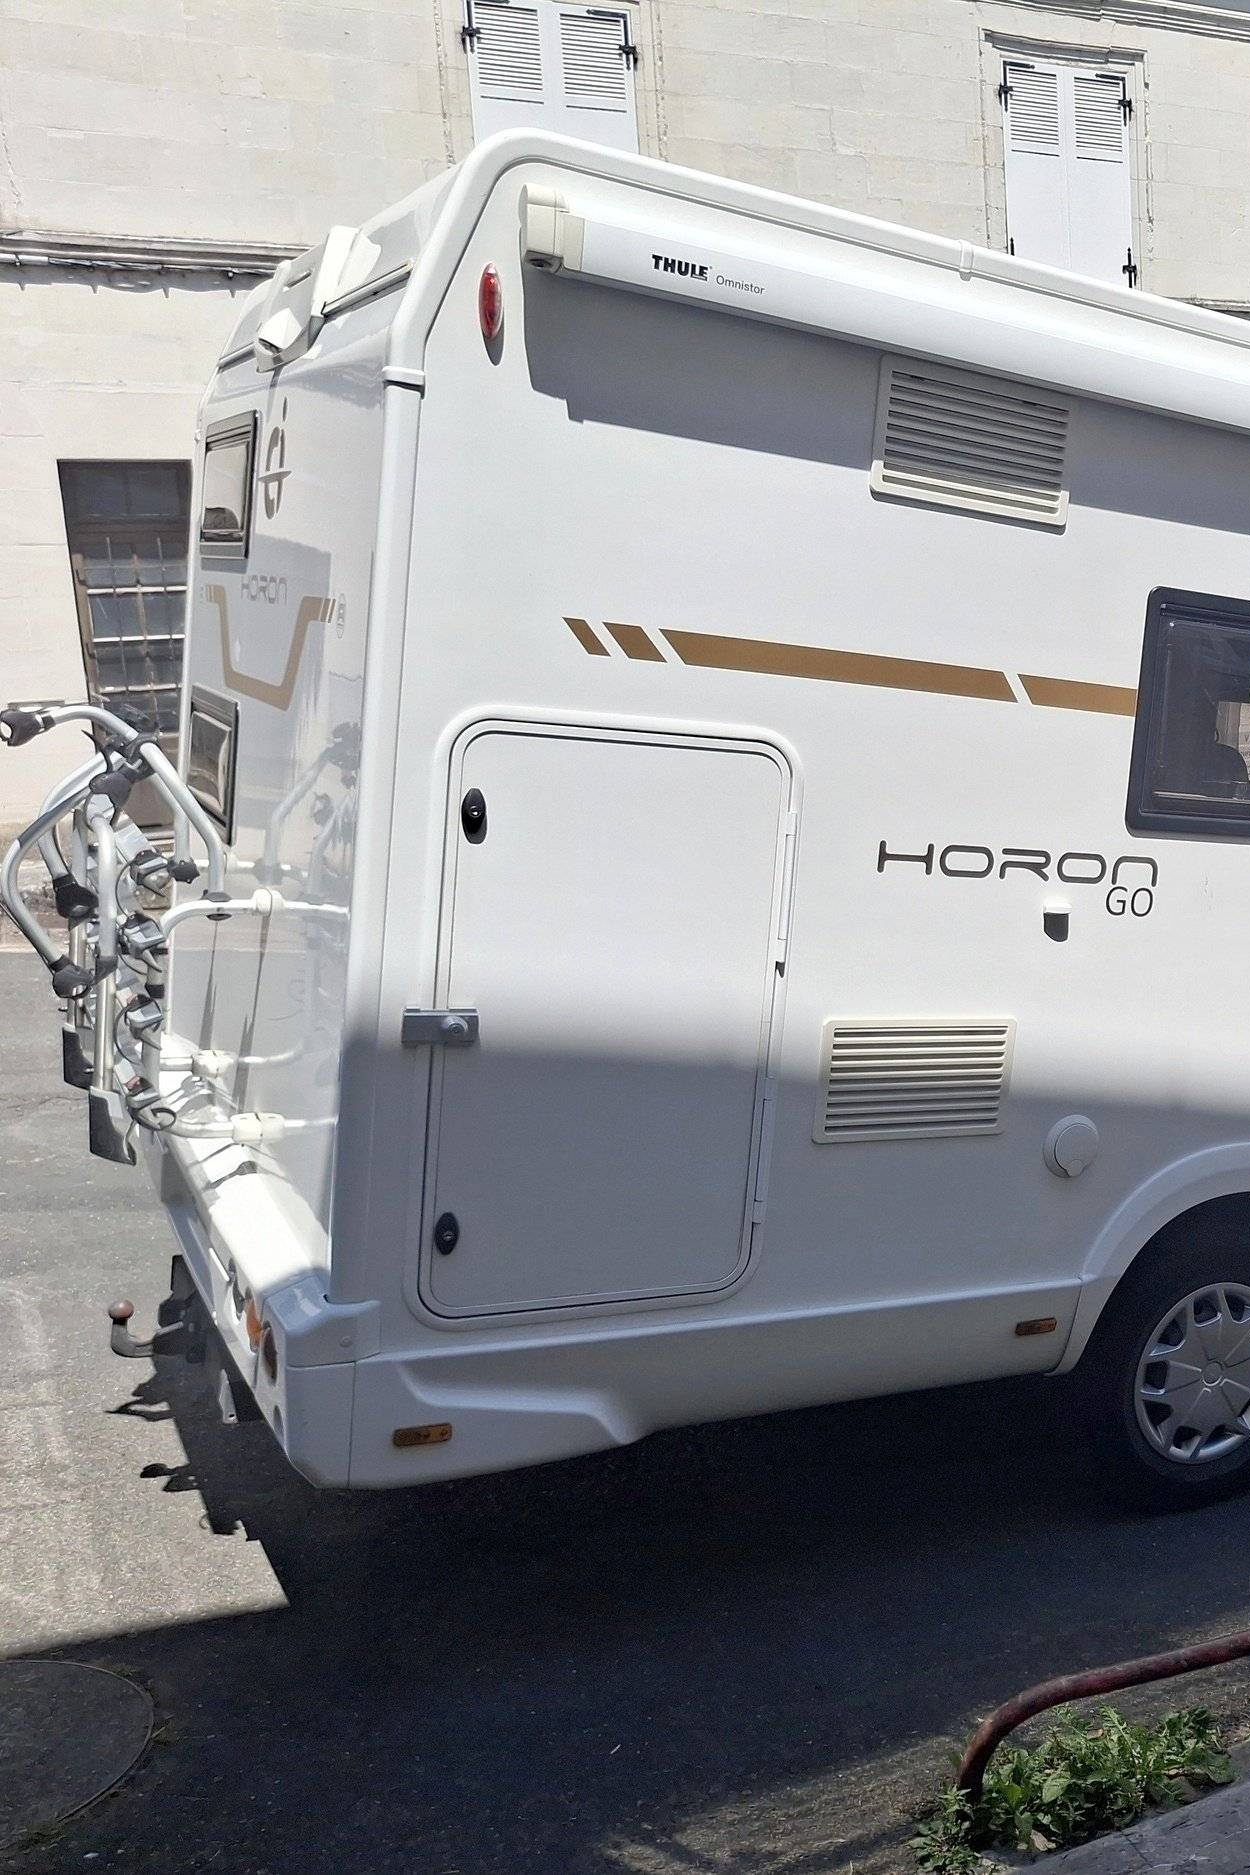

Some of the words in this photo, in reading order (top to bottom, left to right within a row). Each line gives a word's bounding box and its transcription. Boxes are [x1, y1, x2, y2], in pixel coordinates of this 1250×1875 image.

[651, 253, 709, 282] THULE
[715, 274, 766, 295] Omnistor
[877, 839, 1159, 888] HORON
[1104, 886, 1154, 918] GO
